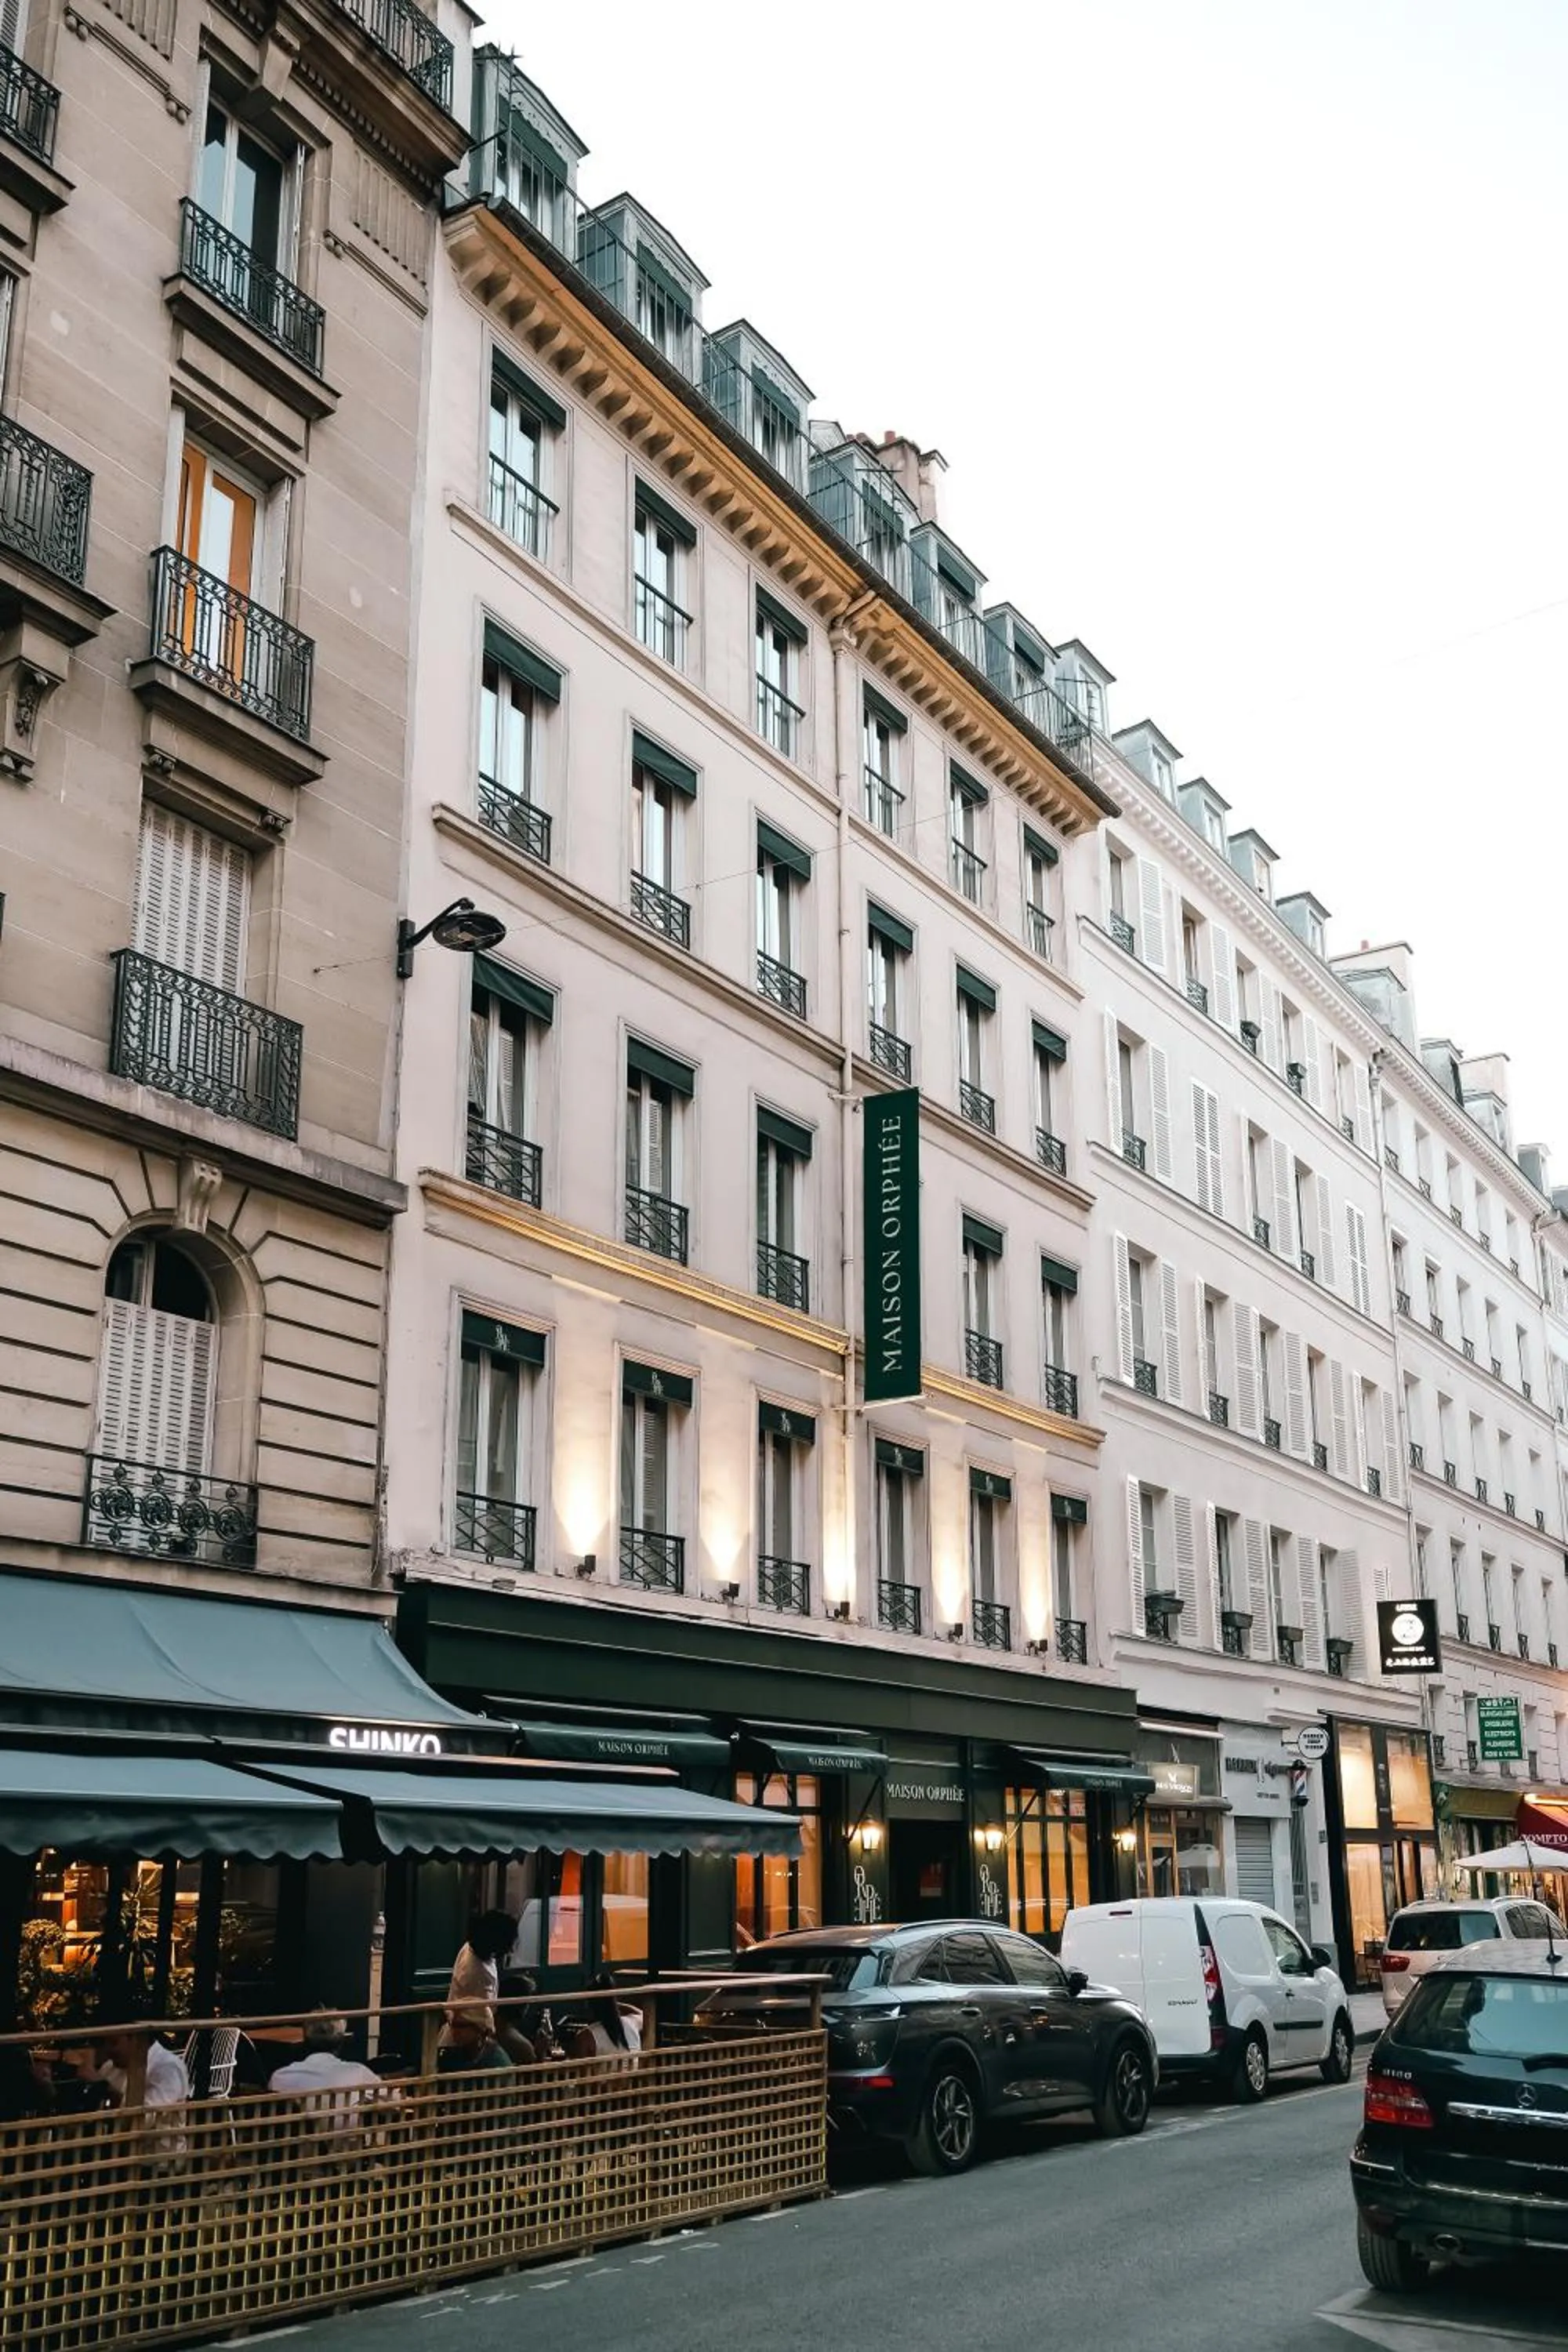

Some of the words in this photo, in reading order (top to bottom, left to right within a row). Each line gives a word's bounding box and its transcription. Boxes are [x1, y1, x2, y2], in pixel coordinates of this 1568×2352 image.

[878, 1115, 902, 1239] ORPHÉE
[882, 1250, 902, 1372] MAISON
[329, 1726, 441, 1755] SHINKO
[598, 1740, 633, 1753] MAISON
[887, 1783, 924, 1799] MAISON
